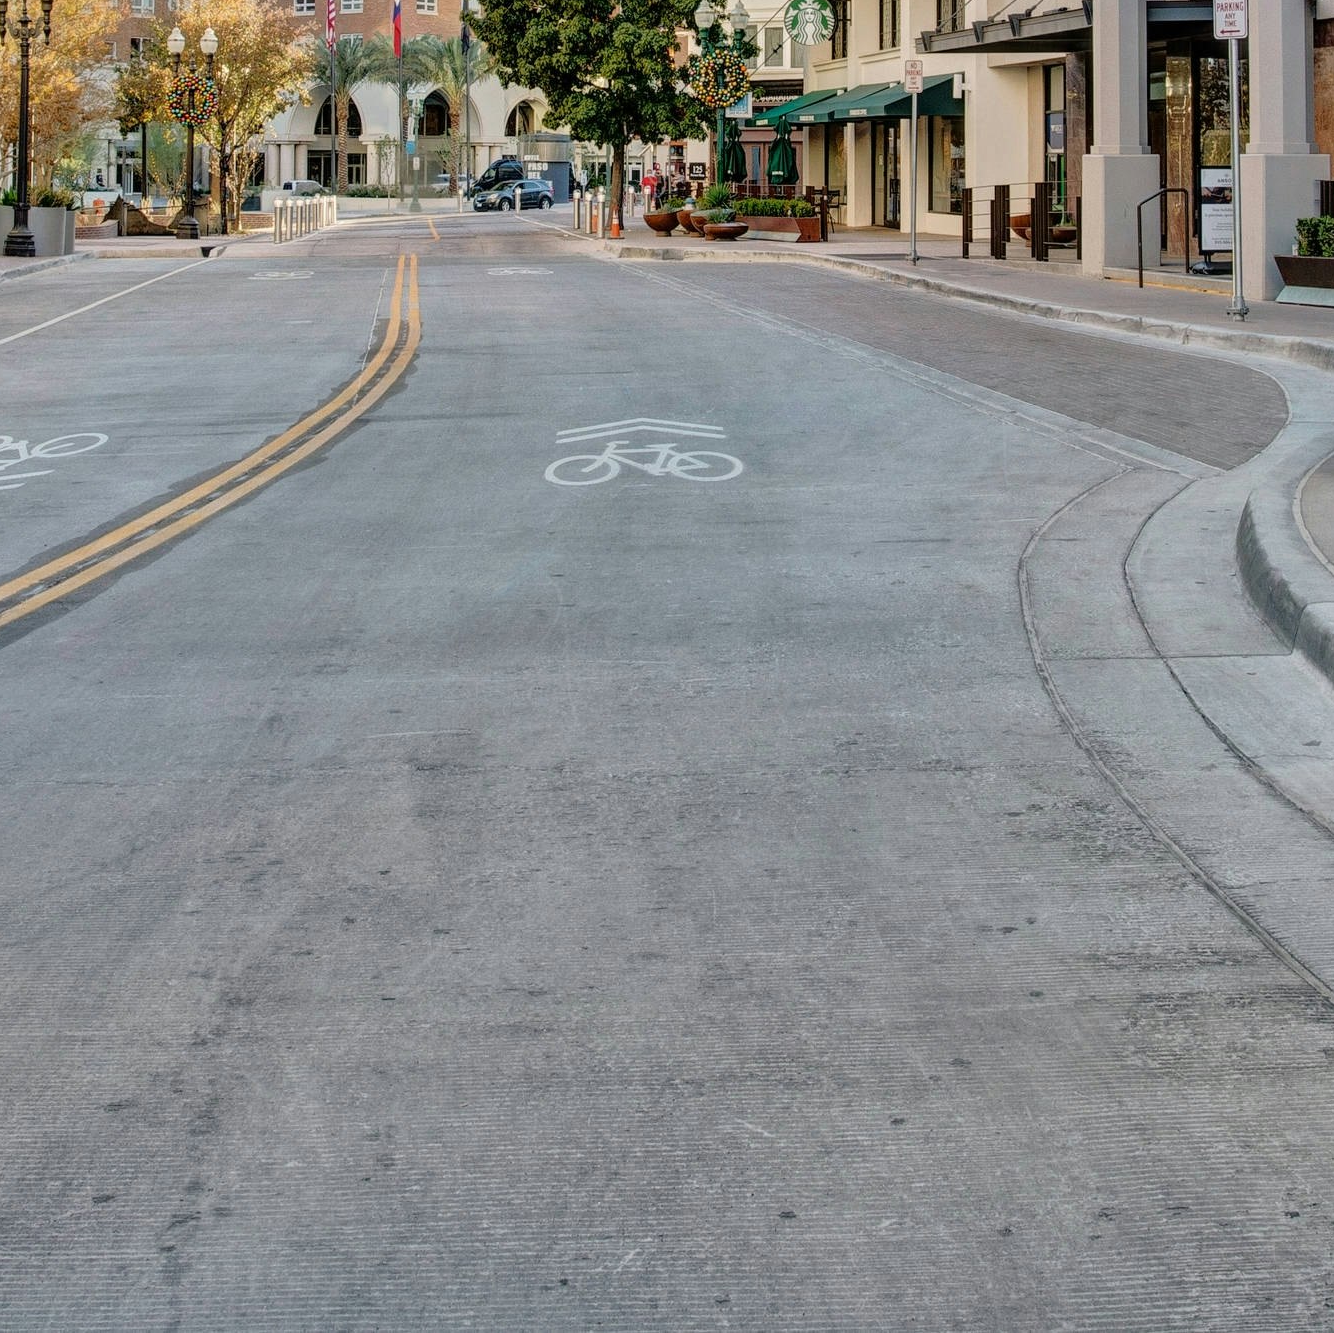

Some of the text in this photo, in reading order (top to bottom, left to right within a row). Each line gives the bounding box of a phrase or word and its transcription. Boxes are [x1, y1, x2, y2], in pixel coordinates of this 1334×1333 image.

[1216, 1, 1244, 12] PARKING
[1224, 12, 1236, 20] ANY
[527, 162, 549, 171] PASO
[692, 165, 703, 174] 125
